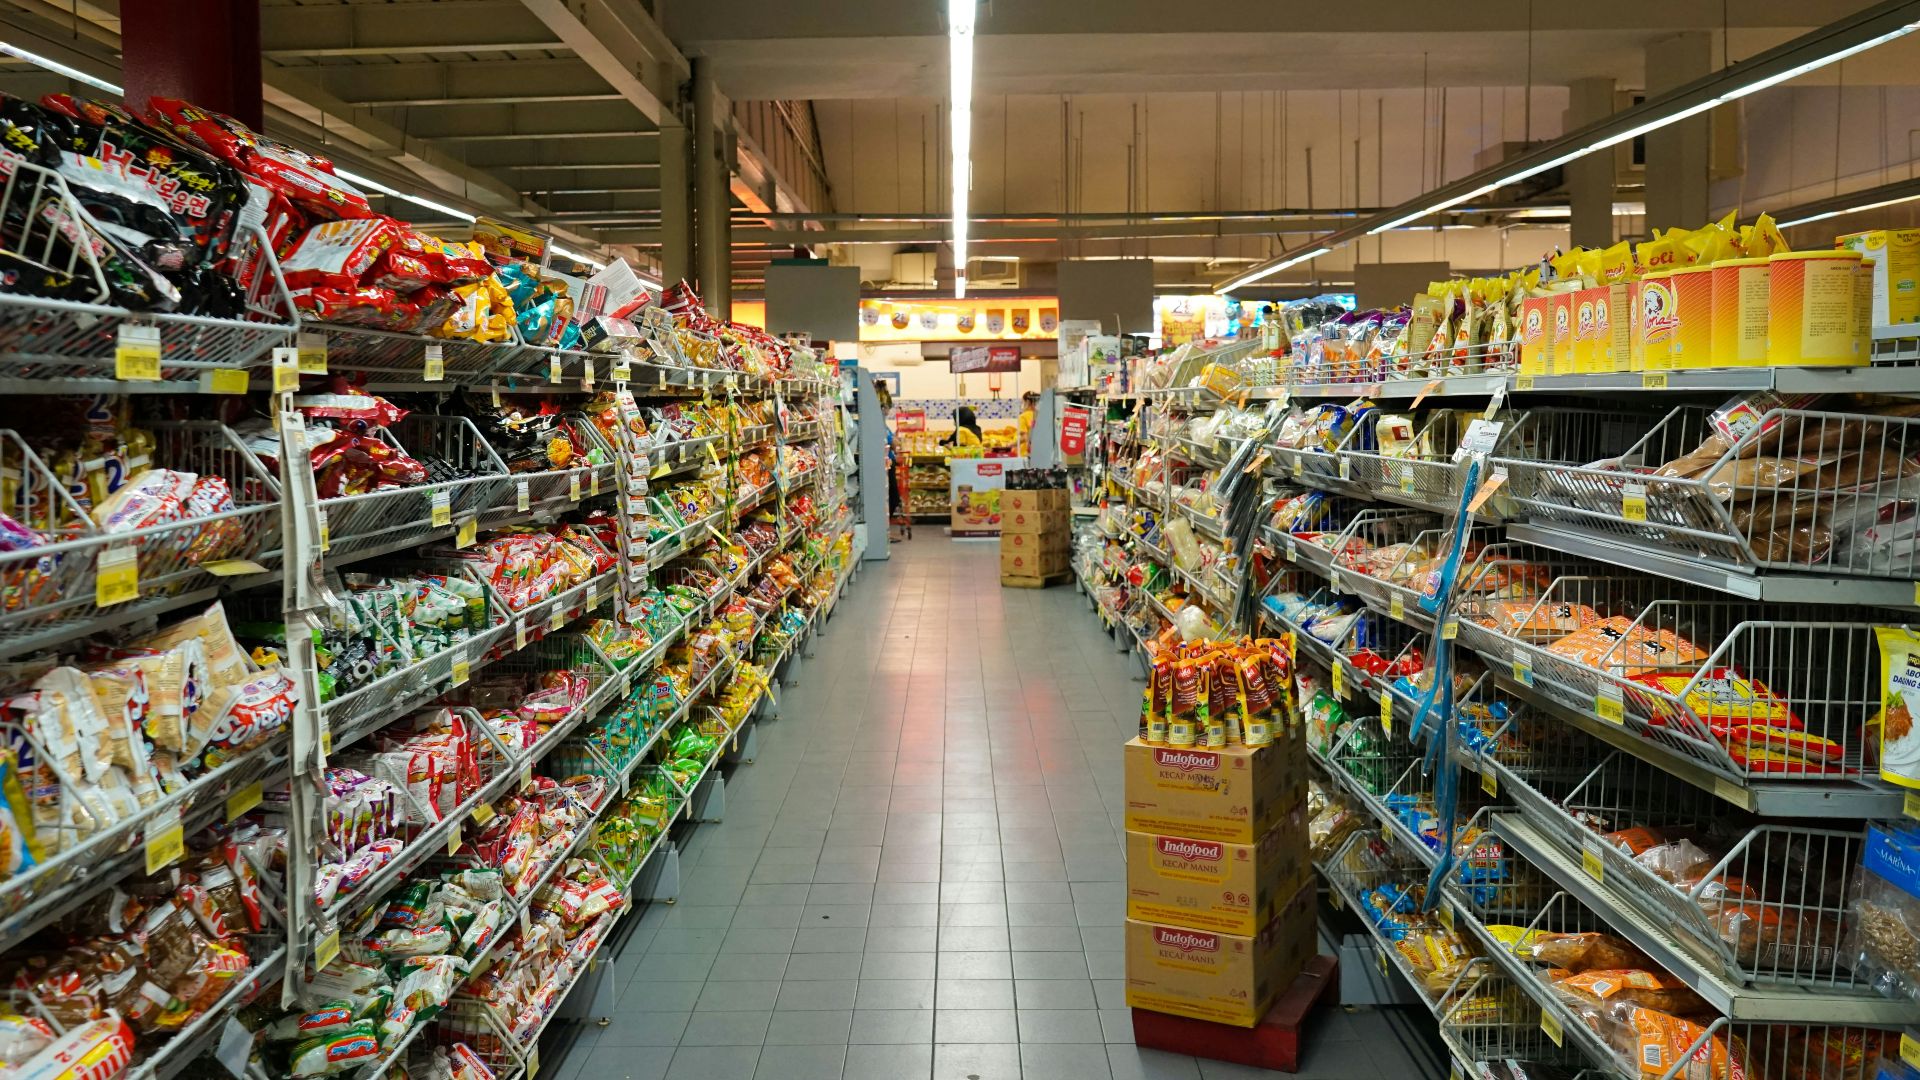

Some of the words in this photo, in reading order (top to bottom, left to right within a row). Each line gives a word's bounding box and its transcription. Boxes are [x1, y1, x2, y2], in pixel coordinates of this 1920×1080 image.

[103, 455, 130, 494] 2
[1161, 751, 1216, 769] Indofood
[1159, 770, 1186, 781] KECAP
[1164, 840, 1219, 858] Indofood
[1162, 859, 1189, 870] KECAP
[1190, 863, 1218, 874] MANIS
[1874, 847, 1916, 875] MARINA
[1160, 931, 1216, 949] Indofood
[1159, 949, 1186, 960] KECAP
[1187, 953, 1216, 964] MANIS
